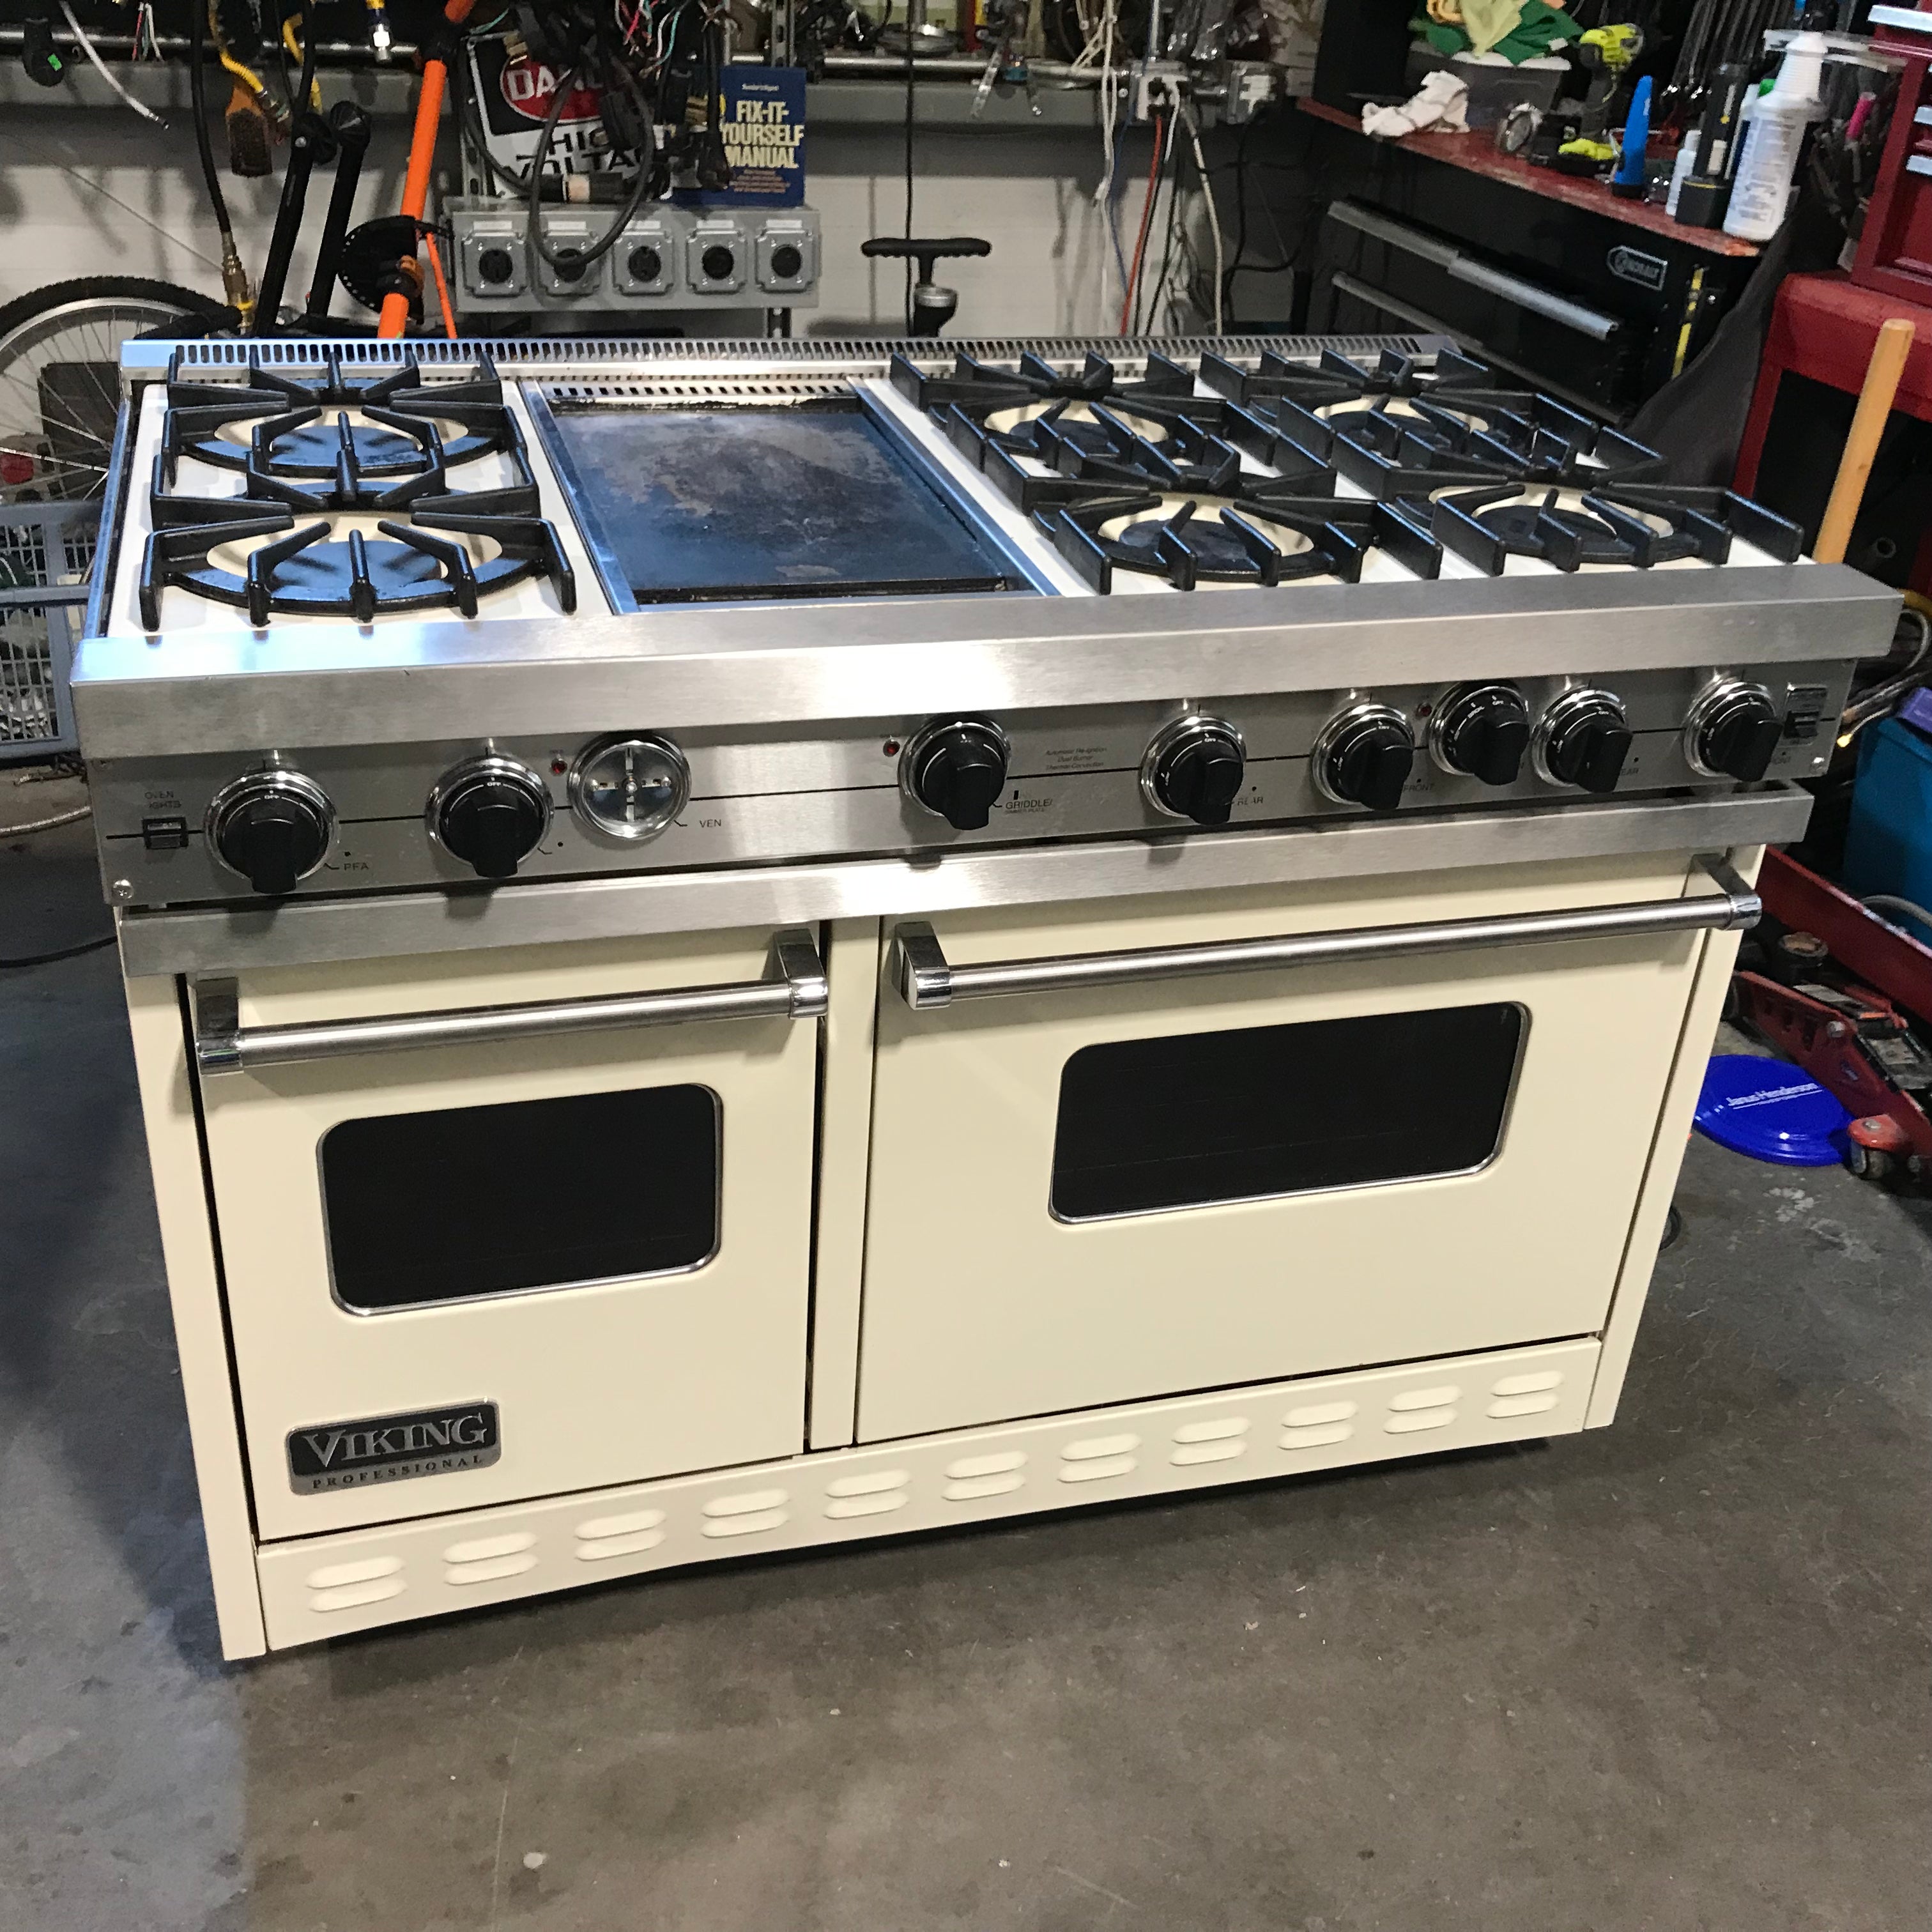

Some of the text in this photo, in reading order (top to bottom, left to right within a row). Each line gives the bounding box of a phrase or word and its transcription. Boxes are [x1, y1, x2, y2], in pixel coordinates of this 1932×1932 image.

[720, 123, 804, 146] YOURSELF
[724, 146, 799, 169] MANUAL
[303, 1412, 488, 1468] VIKING
[312, 1455, 482, 1489] PROFESSIONAL
